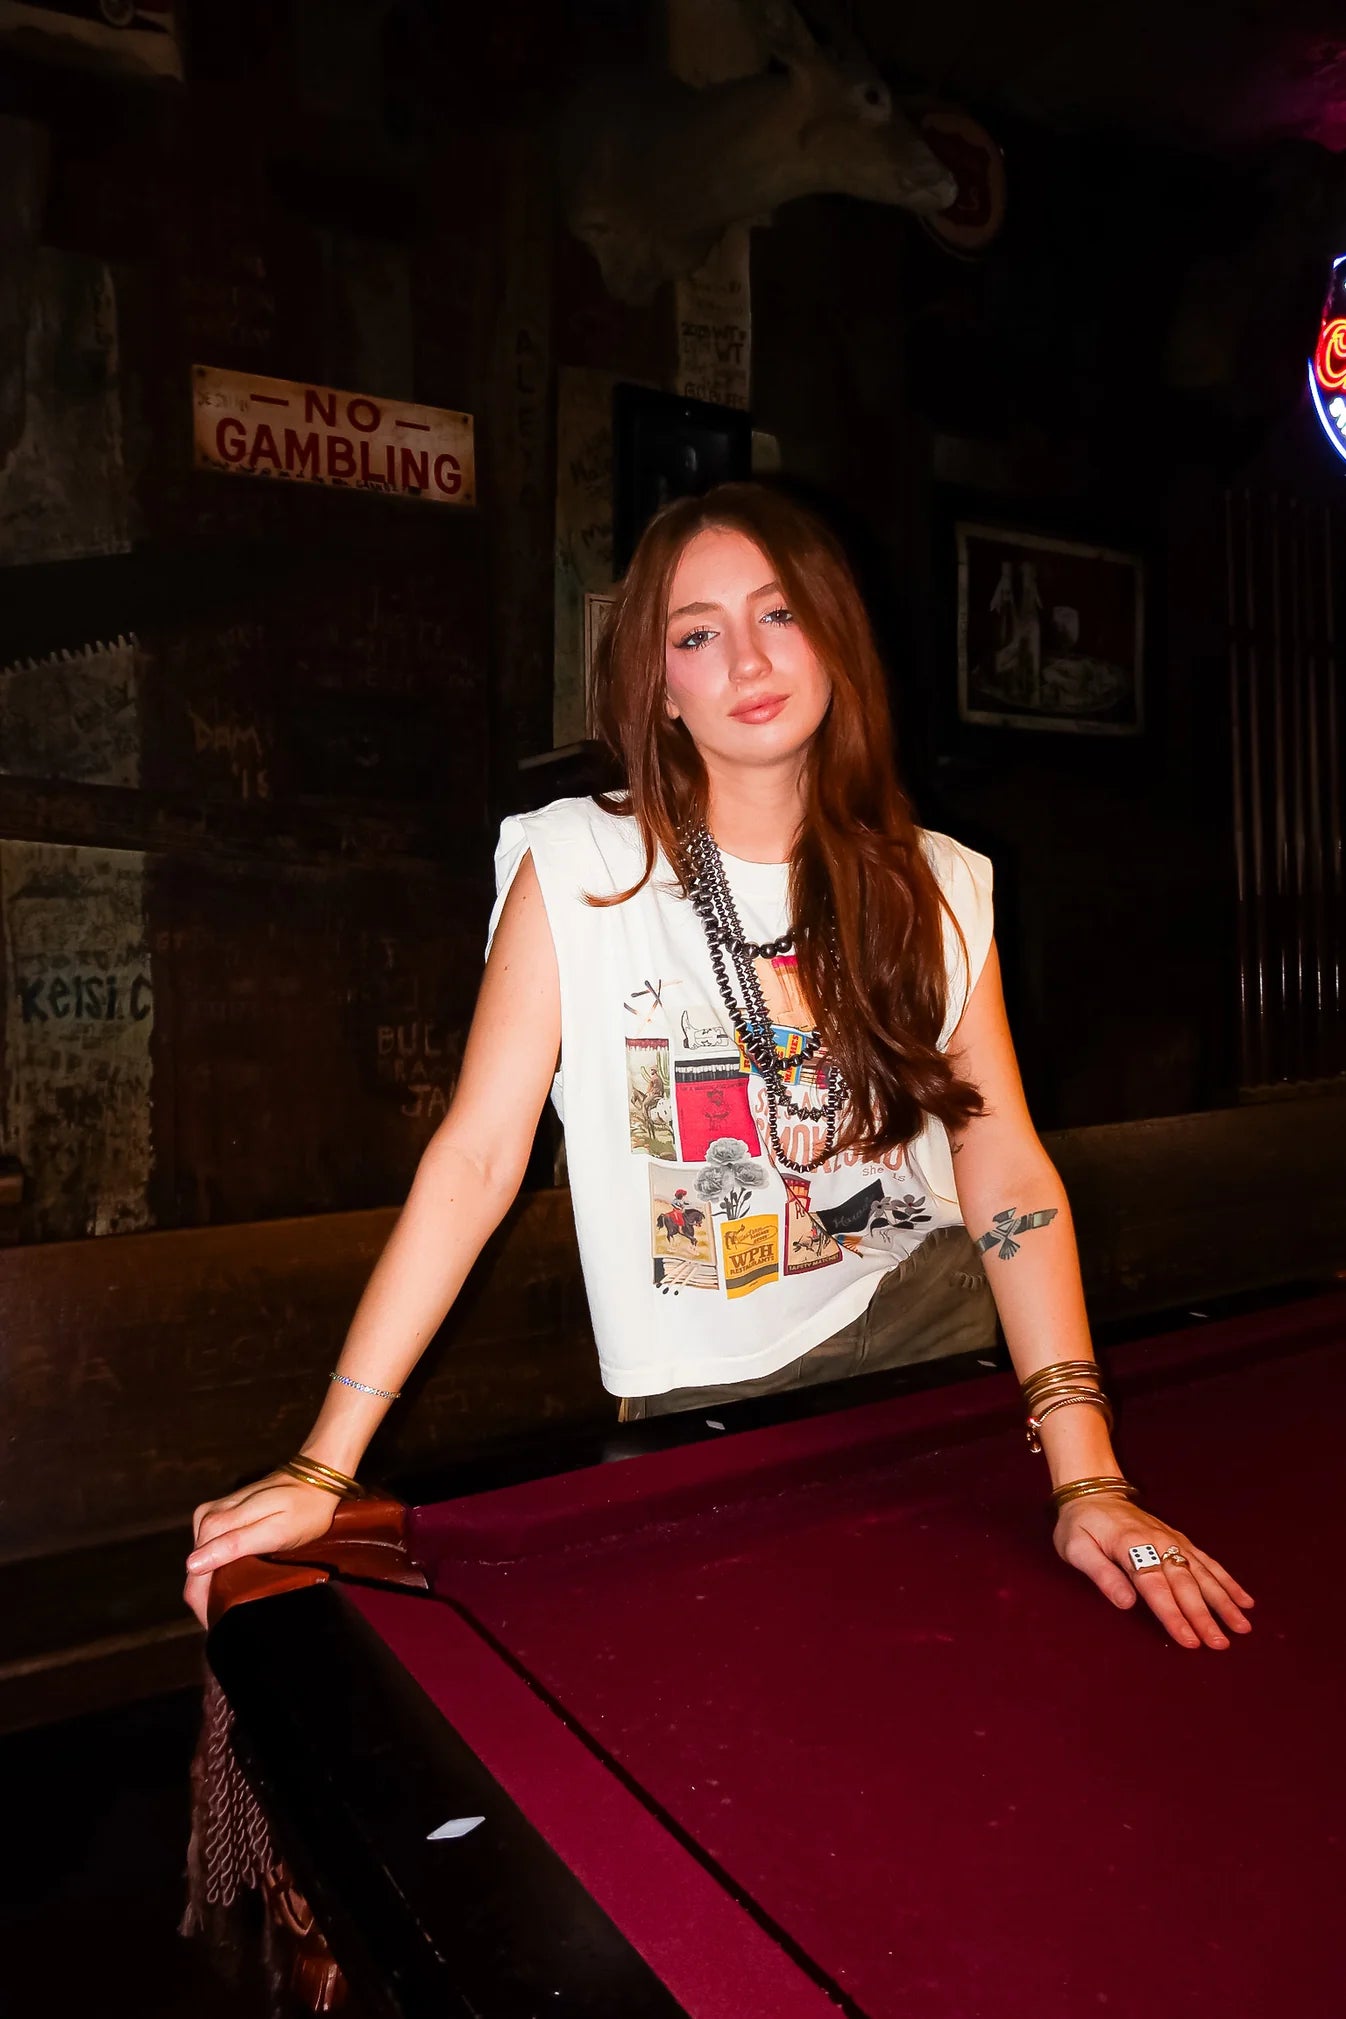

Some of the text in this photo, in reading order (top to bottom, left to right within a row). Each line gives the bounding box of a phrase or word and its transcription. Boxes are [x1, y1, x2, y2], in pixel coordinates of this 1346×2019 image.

[304, 389, 381, 433] NO
[215, 417, 462, 495] GAMBLING
[862, 1165, 906, 1182] she is
[729, 1243, 774, 1269] WPH
